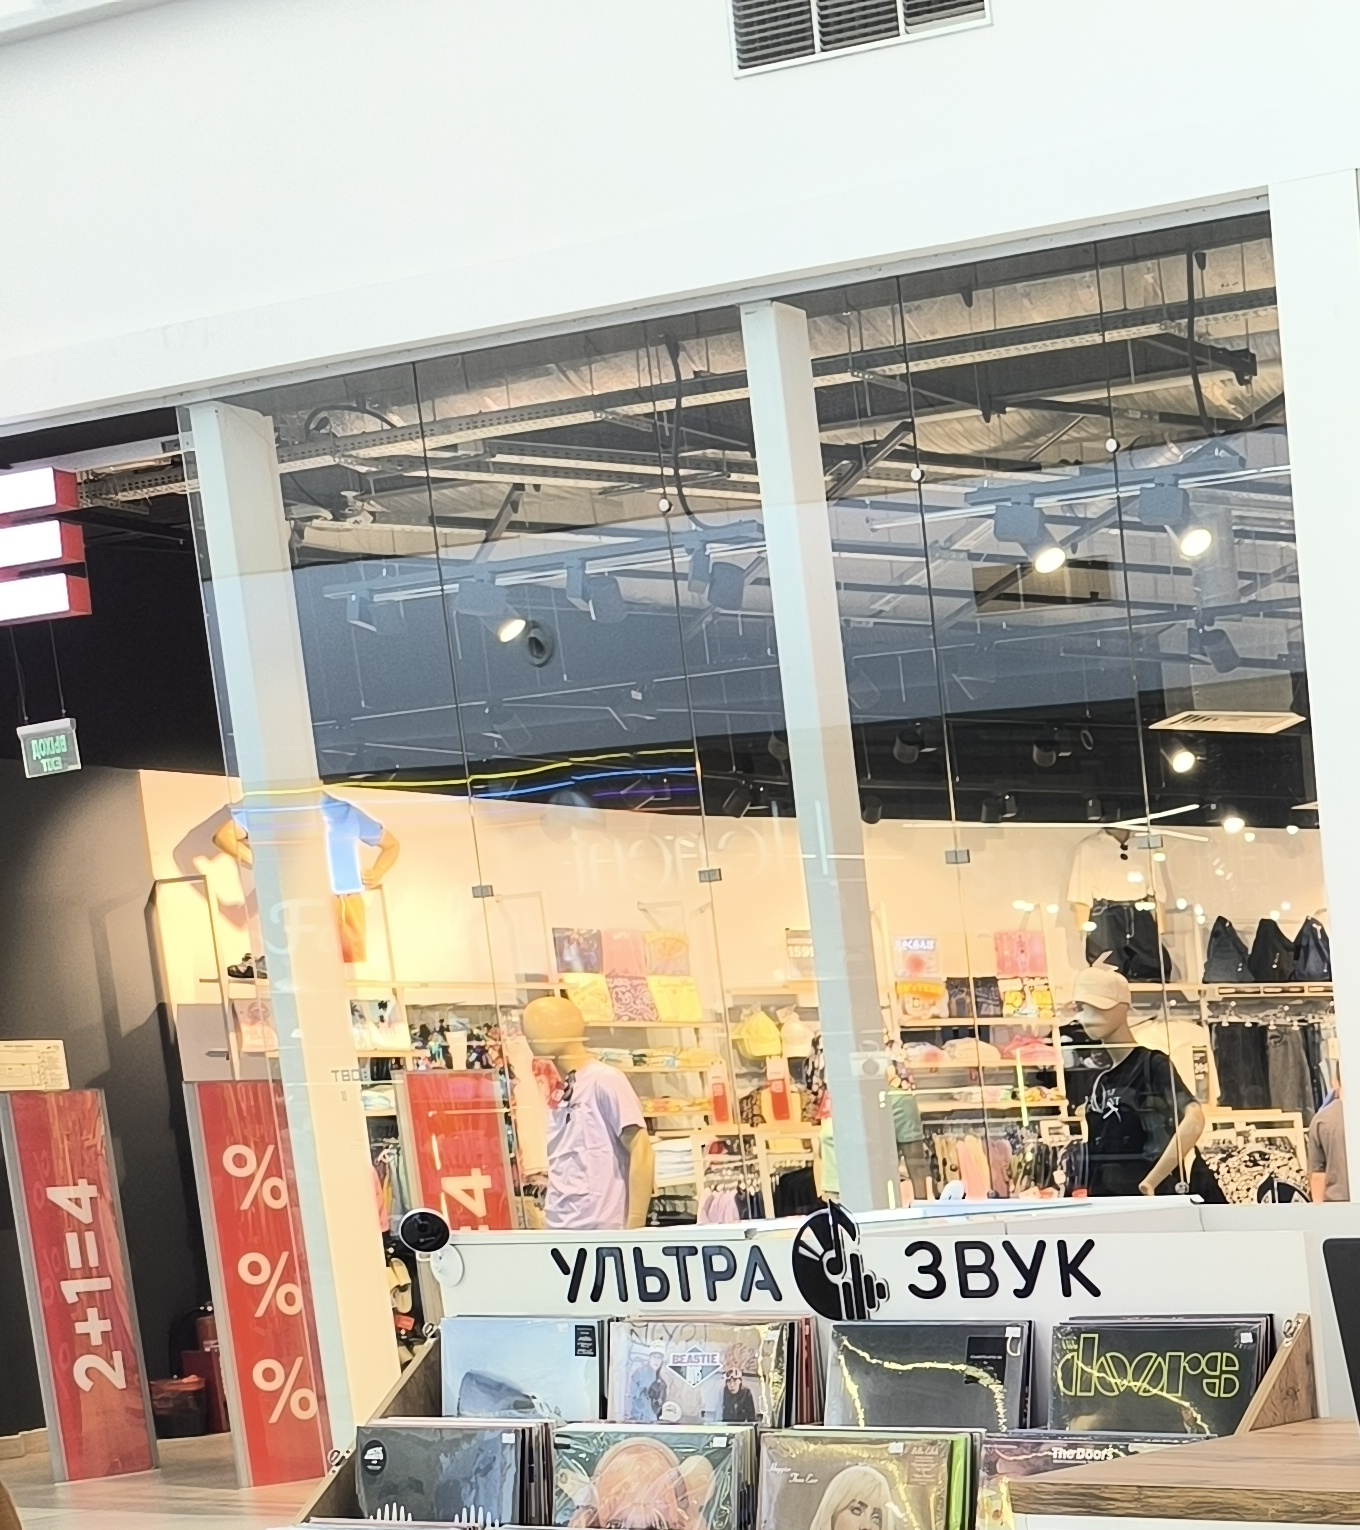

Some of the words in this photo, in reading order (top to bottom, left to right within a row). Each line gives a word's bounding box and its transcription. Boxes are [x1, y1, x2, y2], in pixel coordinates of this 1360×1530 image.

[46, 1178, 127, 1393] 2+1=4
[551, 1244, 783, 1303] УЛЬТРА
[904, 1238, 1102, 1300] ЗВУК
[671, 1352, 719, 1365] BEASTIE
